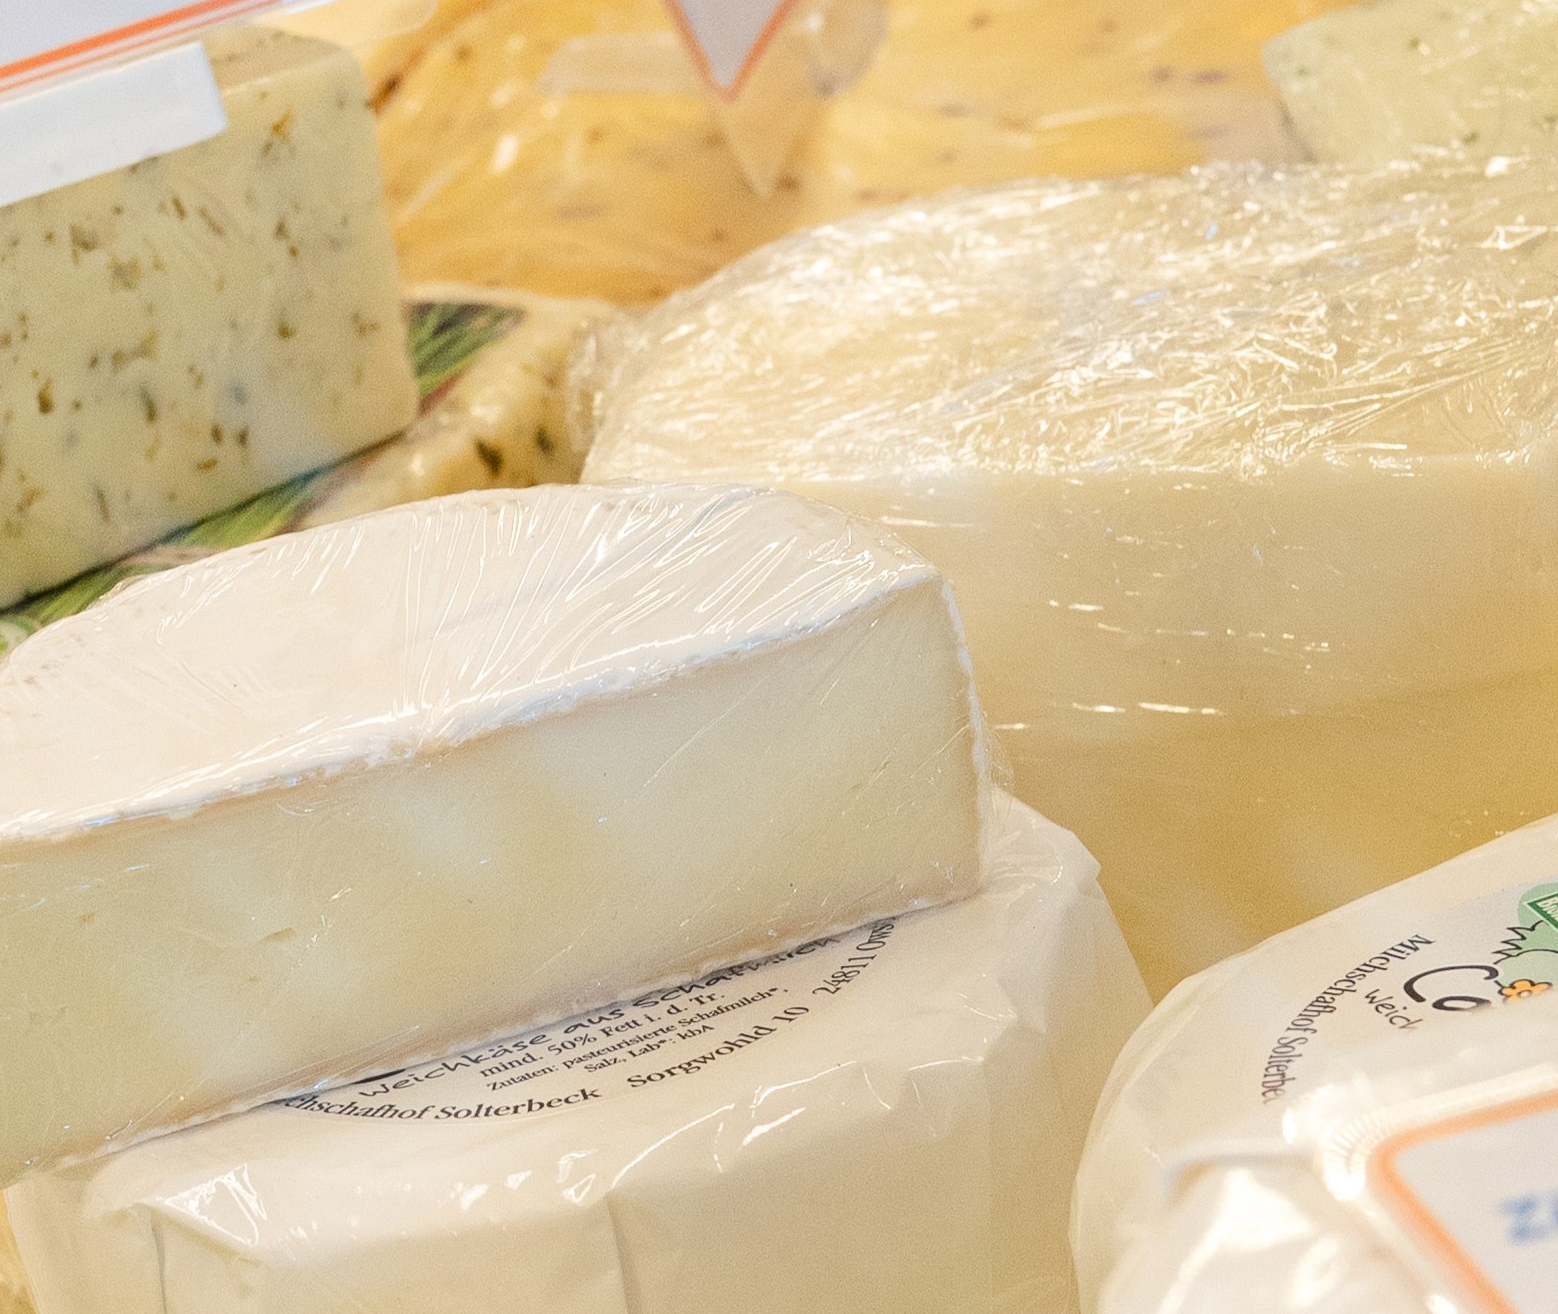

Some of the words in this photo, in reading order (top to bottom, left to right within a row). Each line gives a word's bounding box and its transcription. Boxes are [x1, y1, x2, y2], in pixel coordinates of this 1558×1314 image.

[1284, 933, 1437, 1034] Milchschafhof
[358, 1034, 553, 1098] Weichkäse
[562, 1006, 626, 1035] aus
[433, 1085, 603, 1121] Solterbeck
[625, 1023, 778, 1089] Sorgwohld
[771, 1005, 810, 1025] 10
[811, 954, 877, 995] 24811
[478, 1052, 544, 1079] mind.
[547, 1033, 599, 1057] 50%
[599, 1014, 643, 1037] Fett
[689, 991, 727, 1006] Tr.
[485, 1064, 560, 1092] Zutaten:
[562, 1024, 679, 1069] pasteurisierte
[583, 1056, 628, 1074] Salz,
[679, 1024, 716, 1040] kbA
[1261, 1036, 1310, 1106] Solterbe
